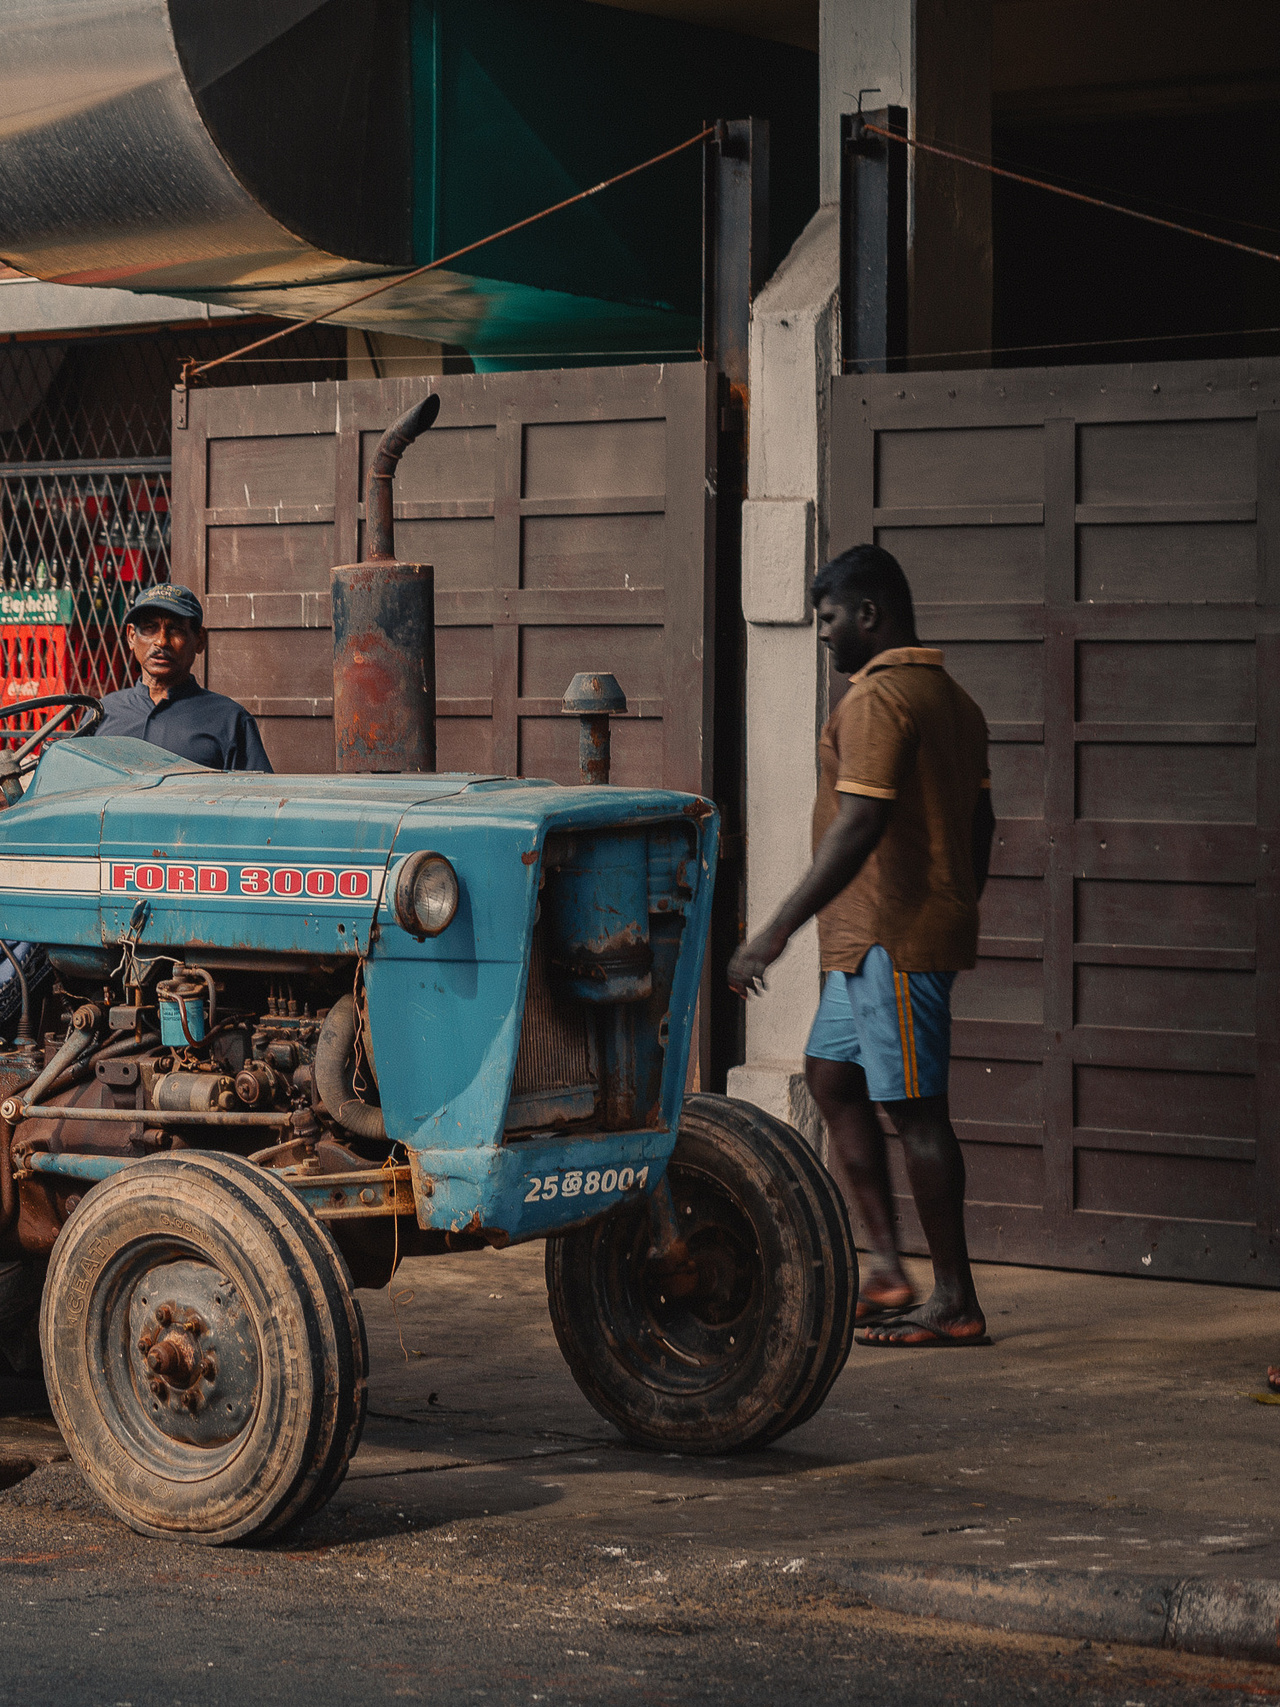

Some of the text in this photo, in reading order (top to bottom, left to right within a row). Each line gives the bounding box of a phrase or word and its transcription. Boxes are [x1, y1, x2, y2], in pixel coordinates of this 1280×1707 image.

[111, 863, 372, 899] FORD 3000
[65, 1236, 107, 1315] CEAT
